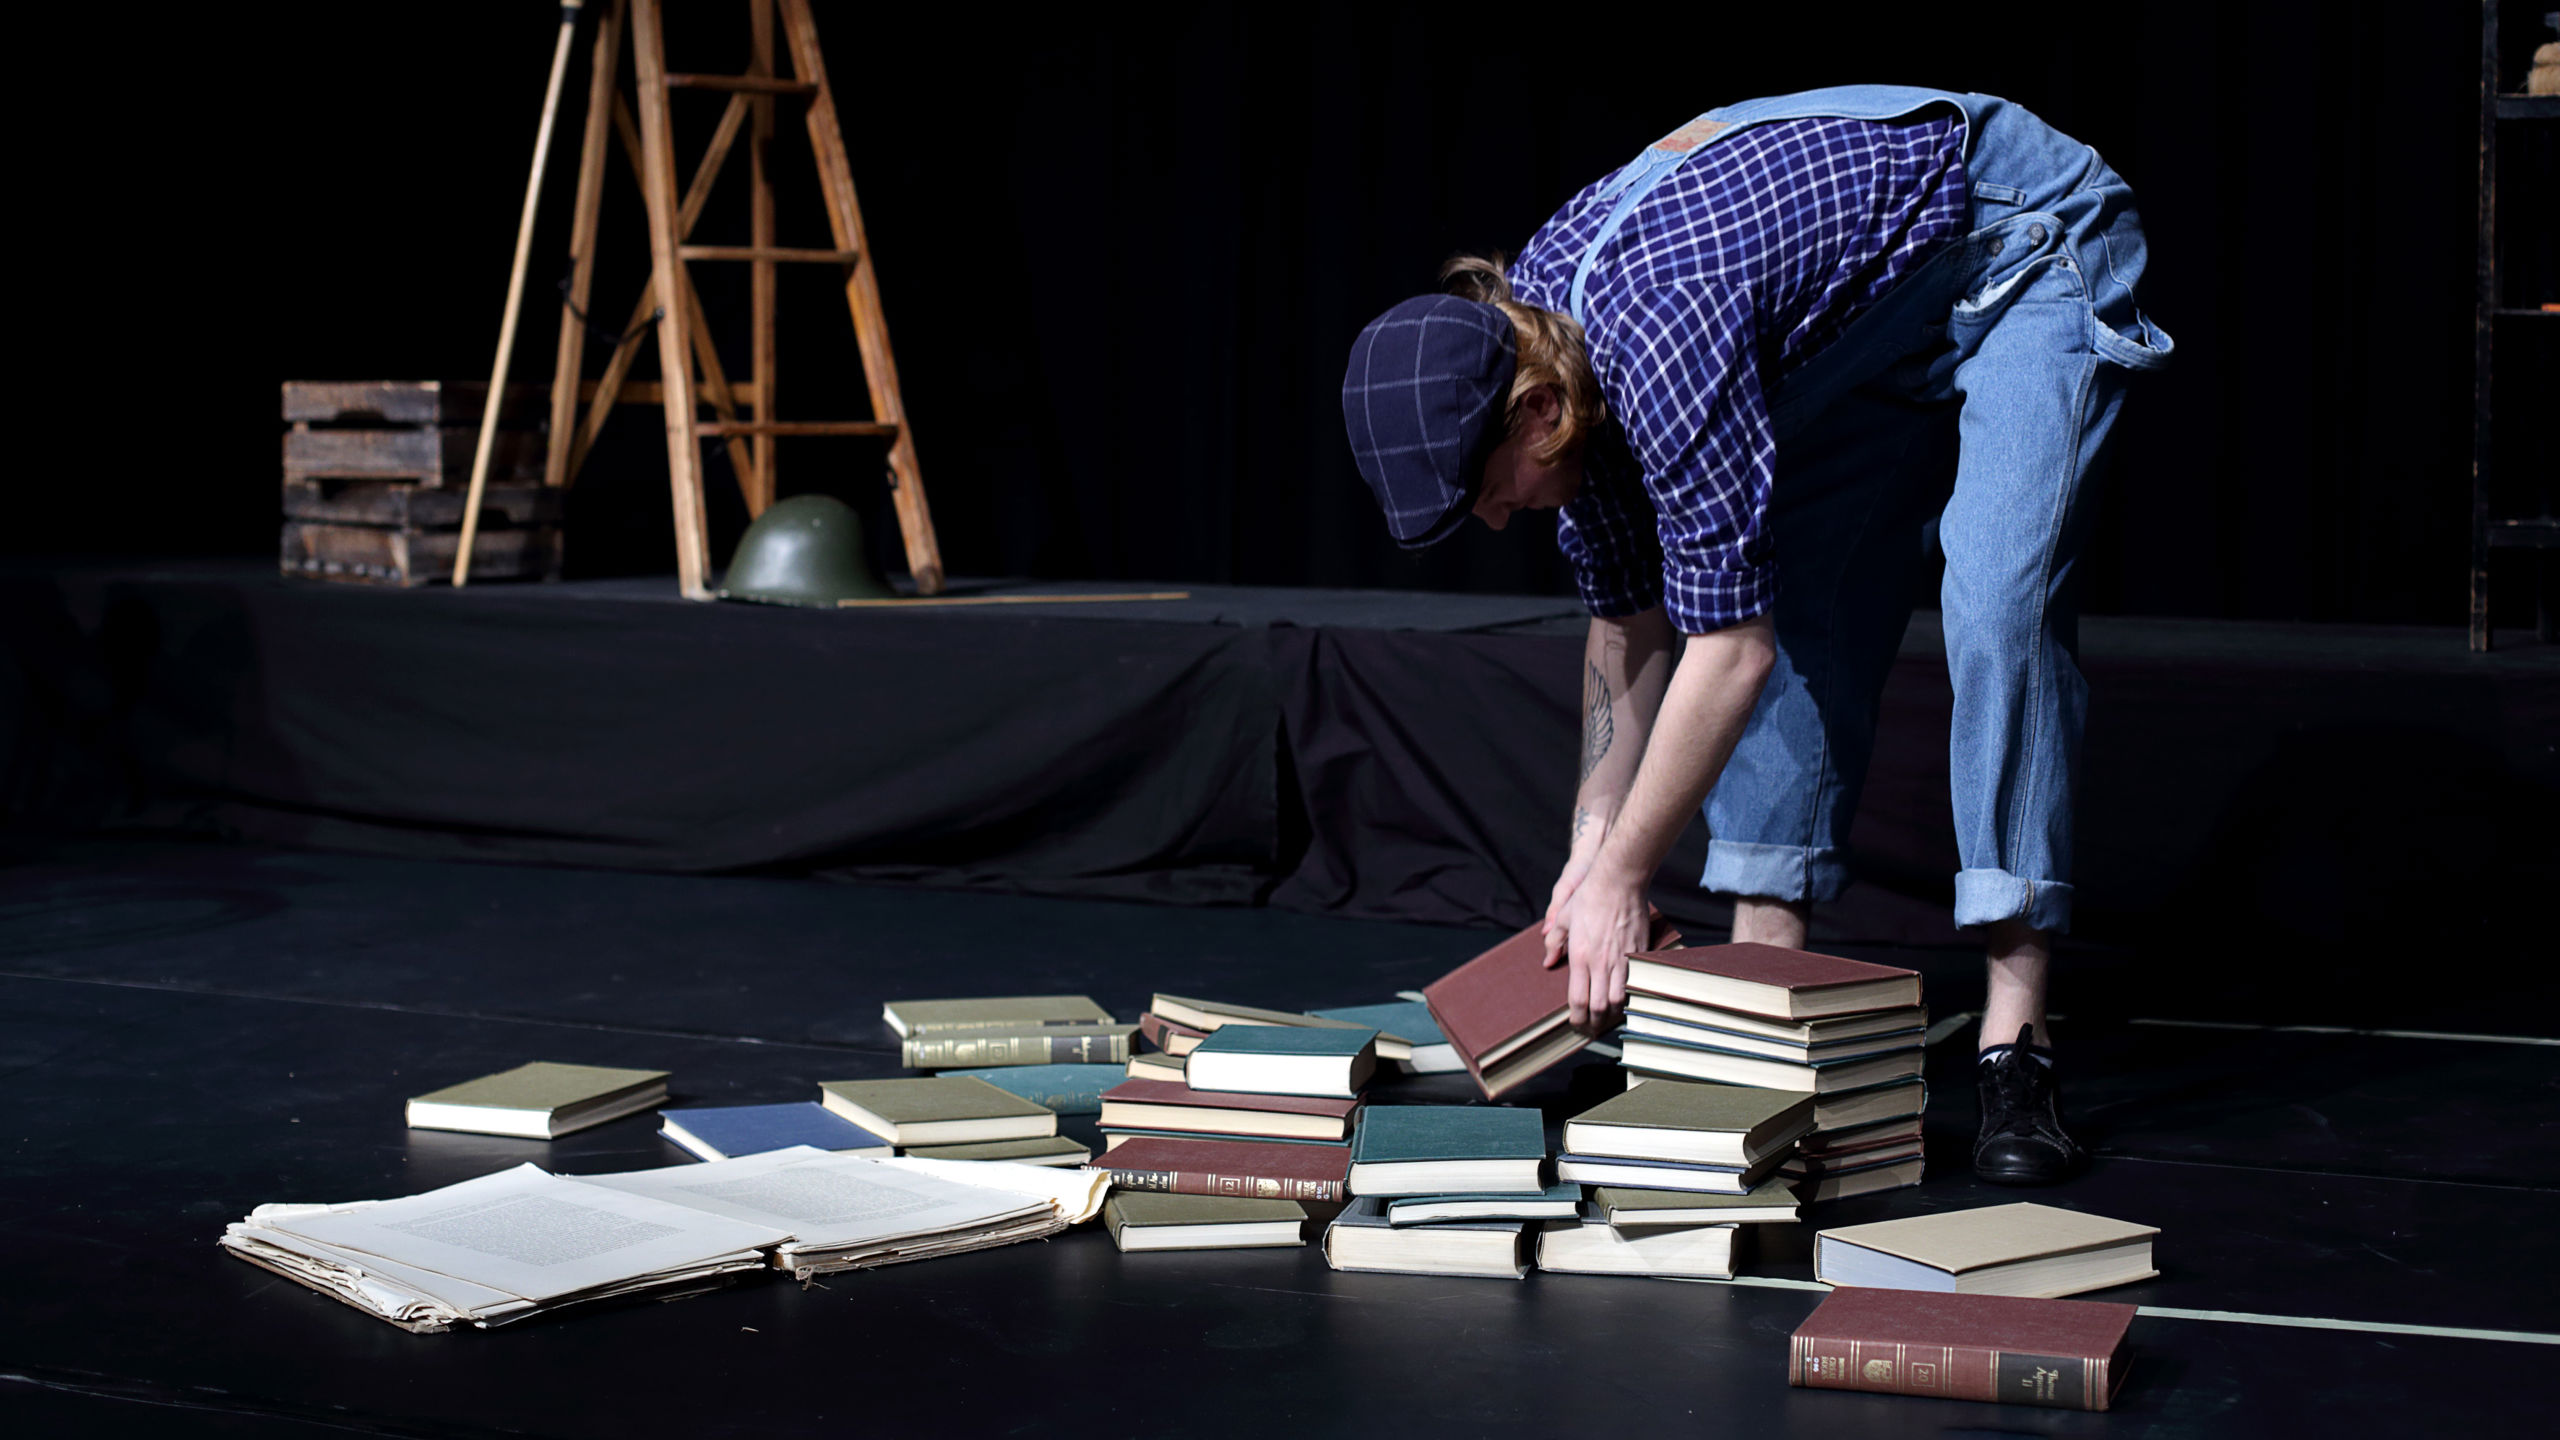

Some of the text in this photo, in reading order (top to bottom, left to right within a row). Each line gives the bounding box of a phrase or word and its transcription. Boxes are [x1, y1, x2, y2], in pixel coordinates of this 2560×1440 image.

[1225, 1181, 1235, 1191] 12
[1918, 1367, 1929, 1383] 20
[2022, 1378, 2033, 1388] II
[2048, 1369, 2059, 1400] Thomas
